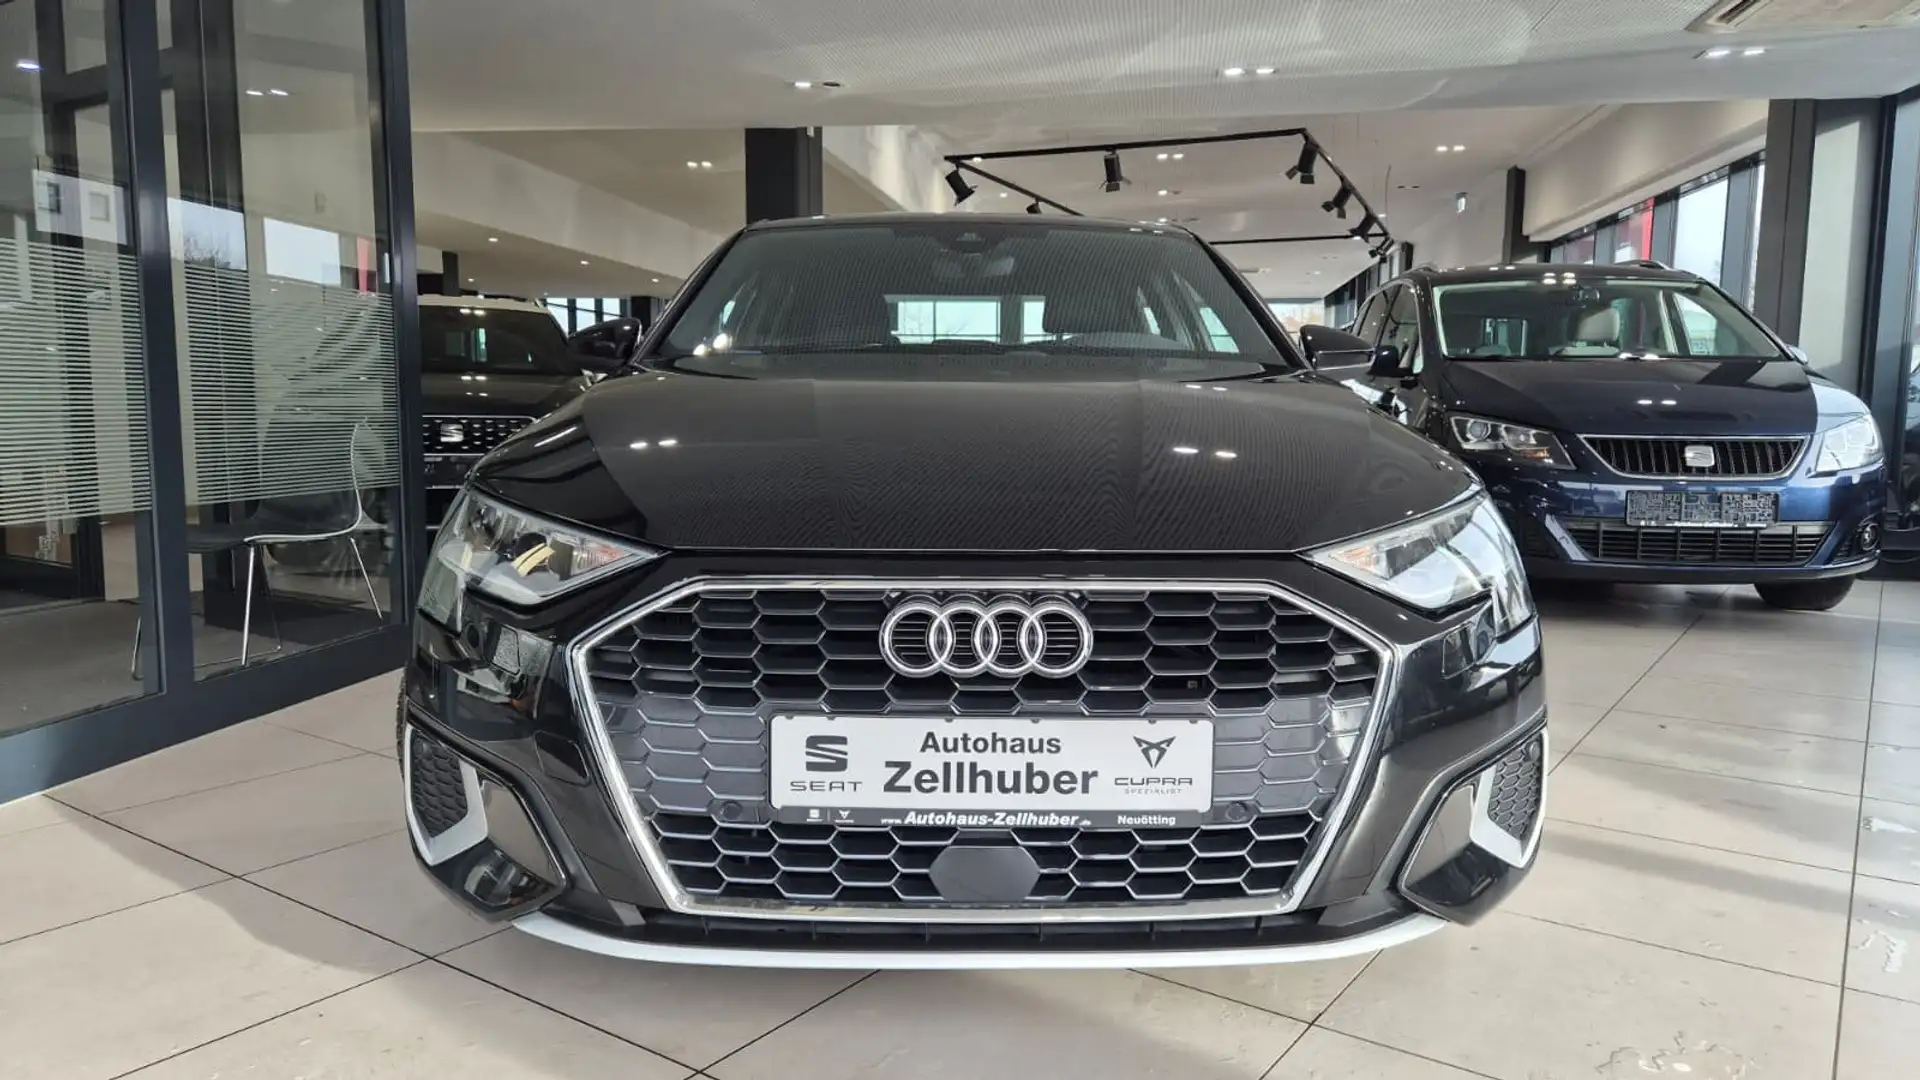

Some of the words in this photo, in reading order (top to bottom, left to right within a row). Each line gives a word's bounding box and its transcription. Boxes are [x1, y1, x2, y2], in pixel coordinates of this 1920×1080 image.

[919, 731, 1062, 754] Autohaus
[883, 760, 1099, 795] Zellhuber
[1114, 777, 1193, 786] CUPRA
[790, 780, 862, 792] SEAT
[1117, 814, 1177, 826] Neuötting
